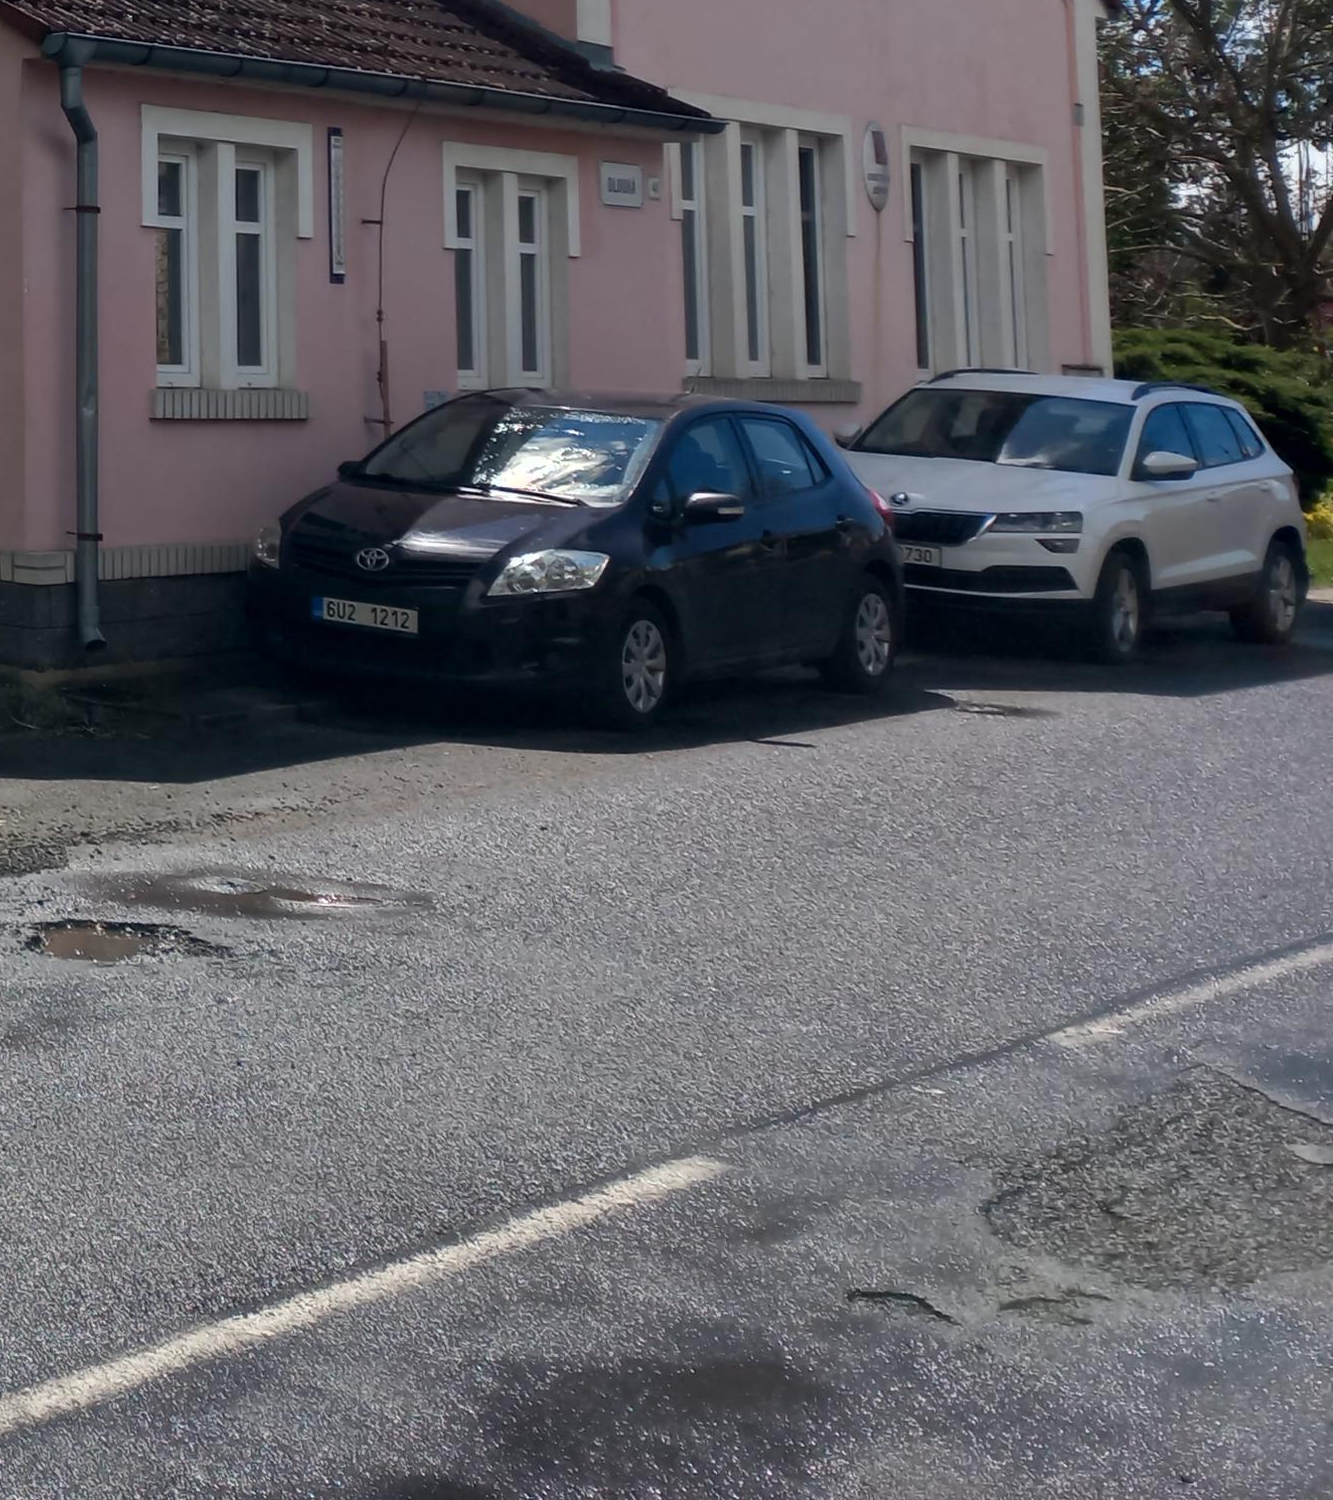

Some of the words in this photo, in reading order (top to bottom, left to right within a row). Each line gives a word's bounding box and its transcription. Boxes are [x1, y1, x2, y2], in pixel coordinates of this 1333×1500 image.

[901, 547, 933, 564] 730
[326, 601, 357, 622] 6U2
[371, 607, 410, 630] 1212
